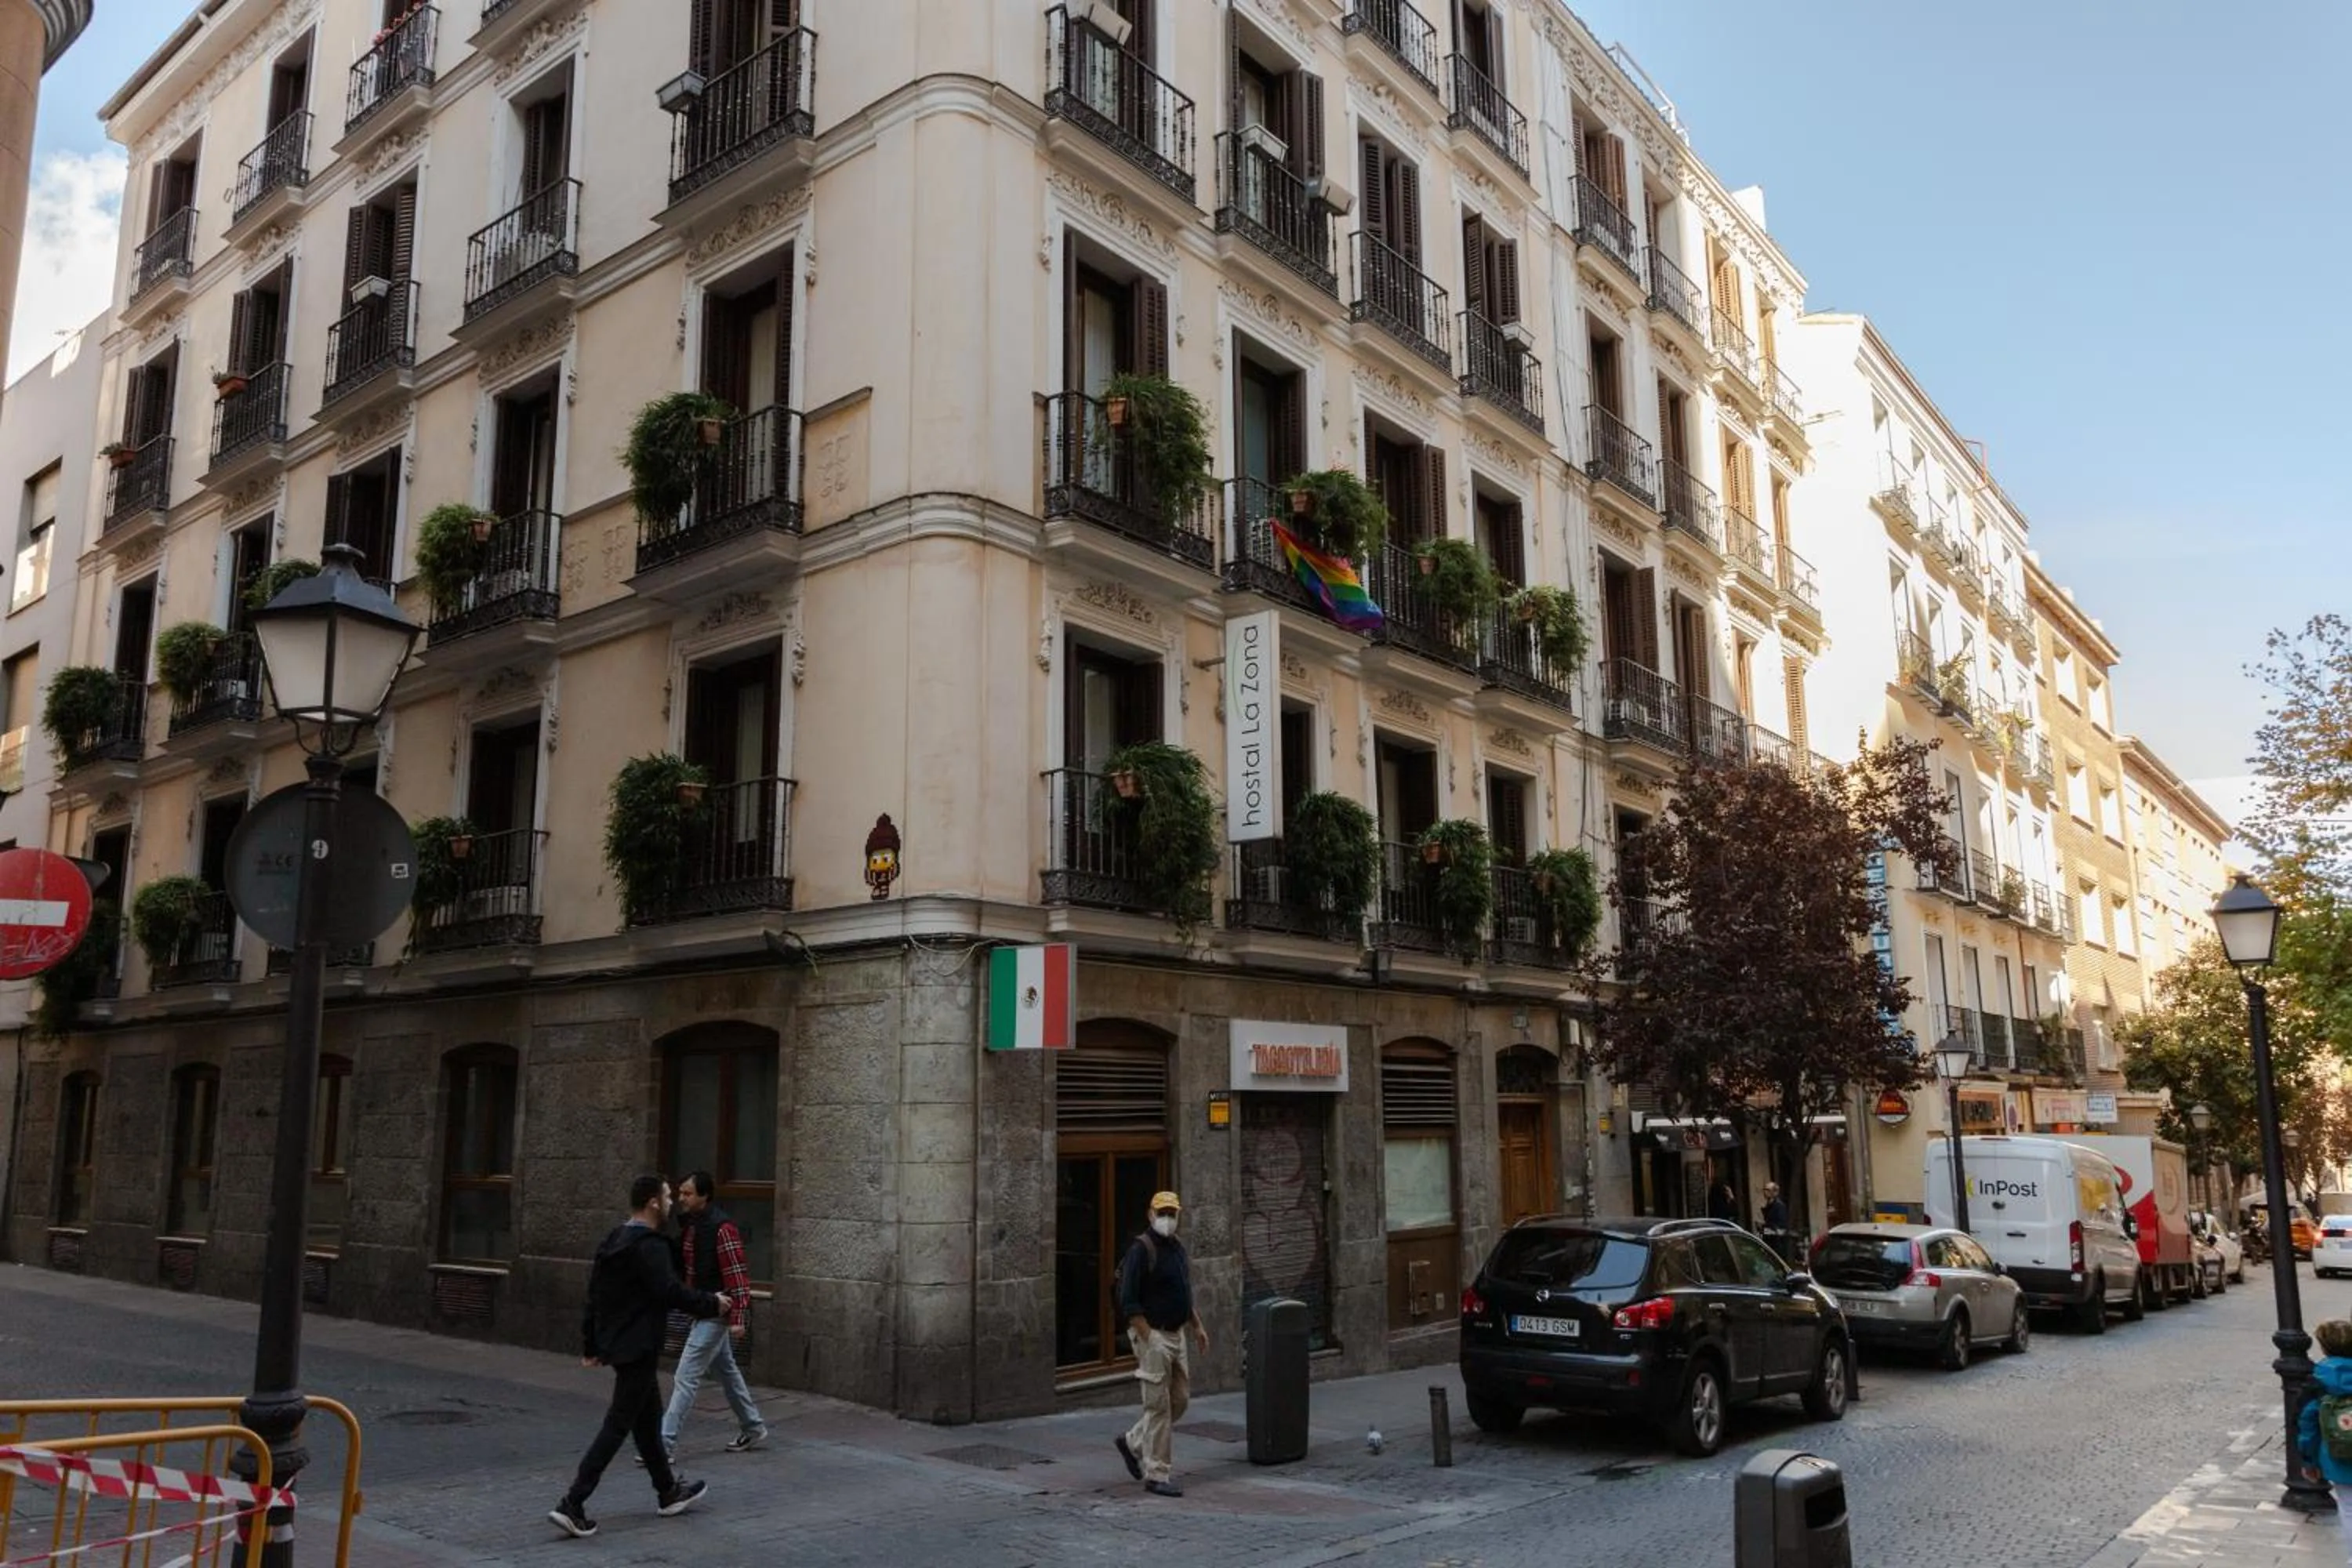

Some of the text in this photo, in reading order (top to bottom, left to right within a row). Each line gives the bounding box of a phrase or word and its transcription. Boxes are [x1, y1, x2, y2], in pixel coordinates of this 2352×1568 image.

[1240, 625, 1261, 826] hostal La Zona
[1980, 1179, 2038, 1197] InPost
[1519, 1316, 1548, 1332] 0413
